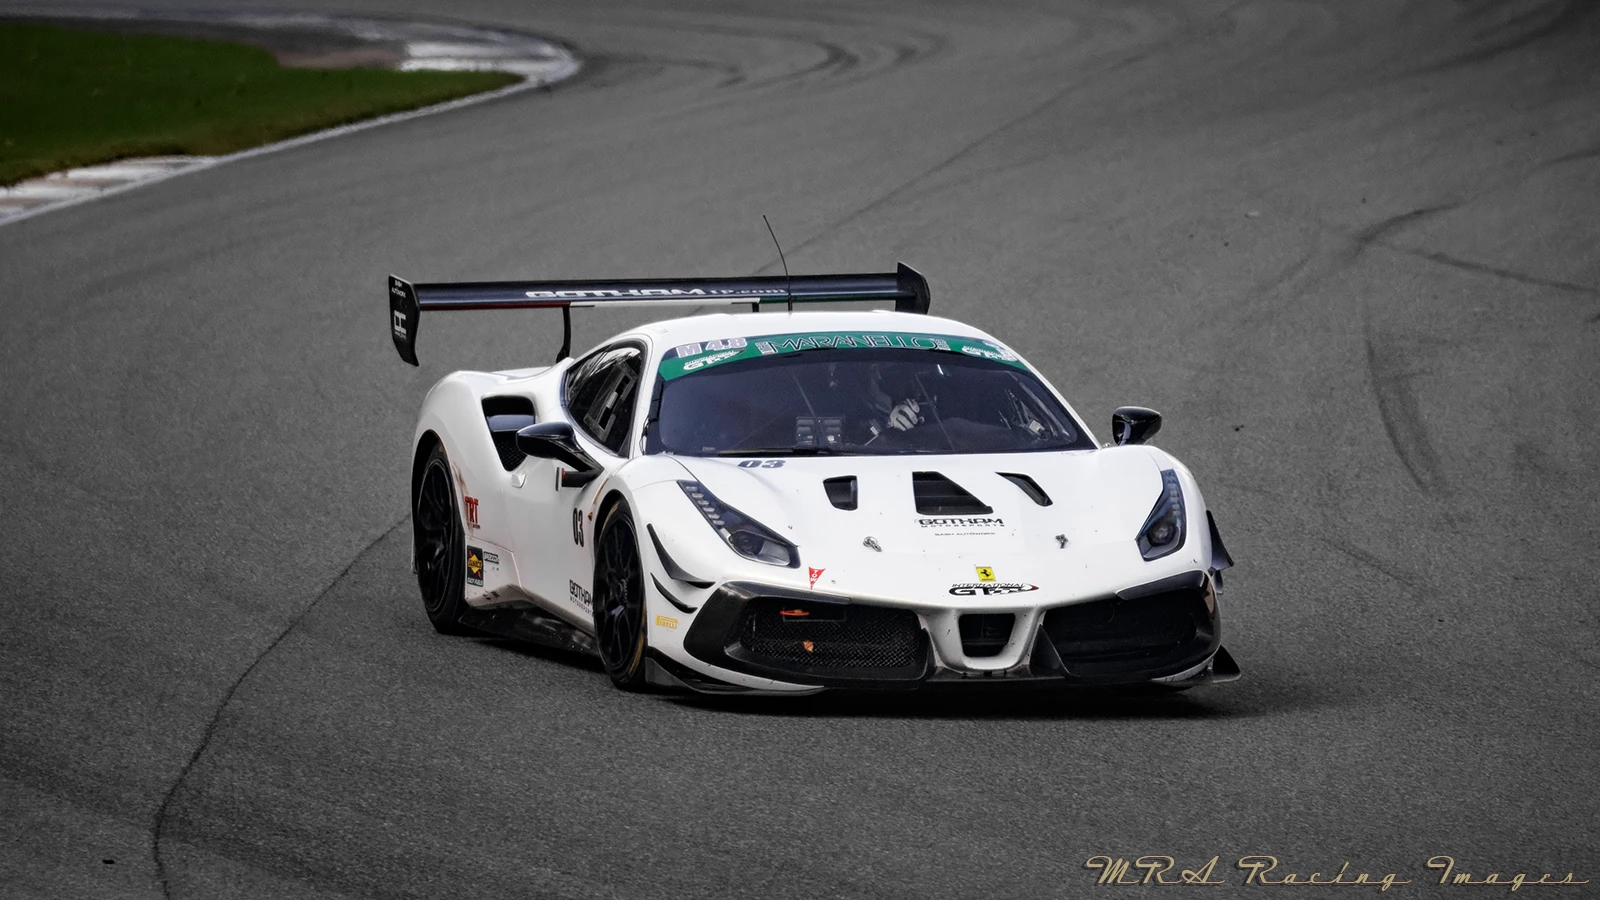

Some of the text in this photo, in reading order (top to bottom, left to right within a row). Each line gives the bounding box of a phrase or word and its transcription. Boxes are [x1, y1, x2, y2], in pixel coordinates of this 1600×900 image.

[525, 288, 706, 298] GOTHAM
[675, 342, 702, 358] M
[737, 459, 786, 468] 03
[572, 507, 585, 548] 03
[810, 569, 818, 582] TOW
